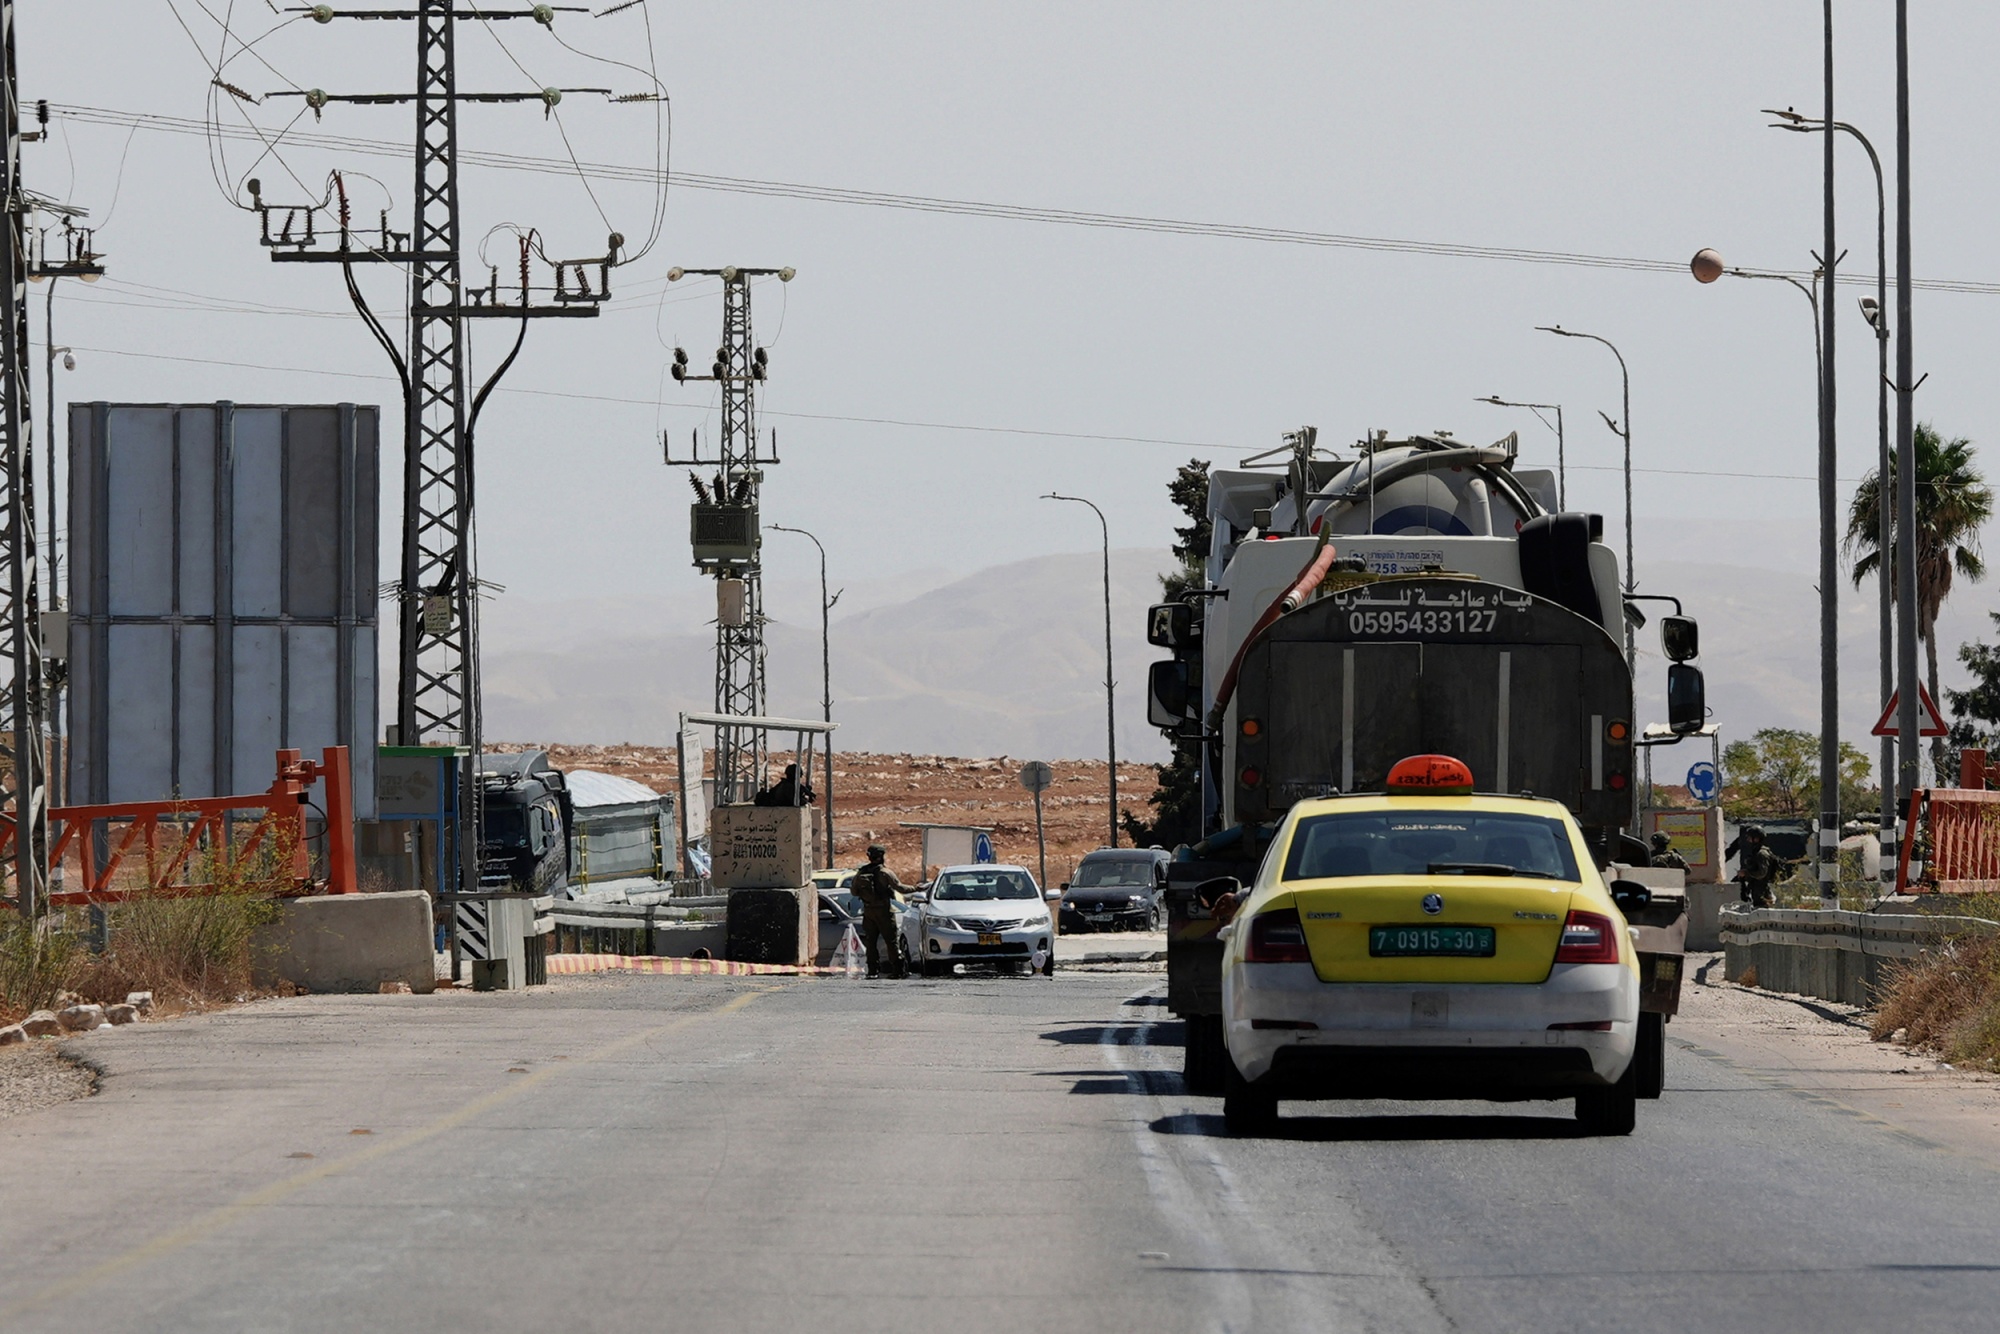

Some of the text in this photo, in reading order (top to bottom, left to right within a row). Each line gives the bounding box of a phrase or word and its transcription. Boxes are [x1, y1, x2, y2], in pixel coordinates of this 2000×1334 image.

[1334, 587, 1533, 612] مياه صالحة للشرب
[1349, 610, 1497, 634] 0595433127
